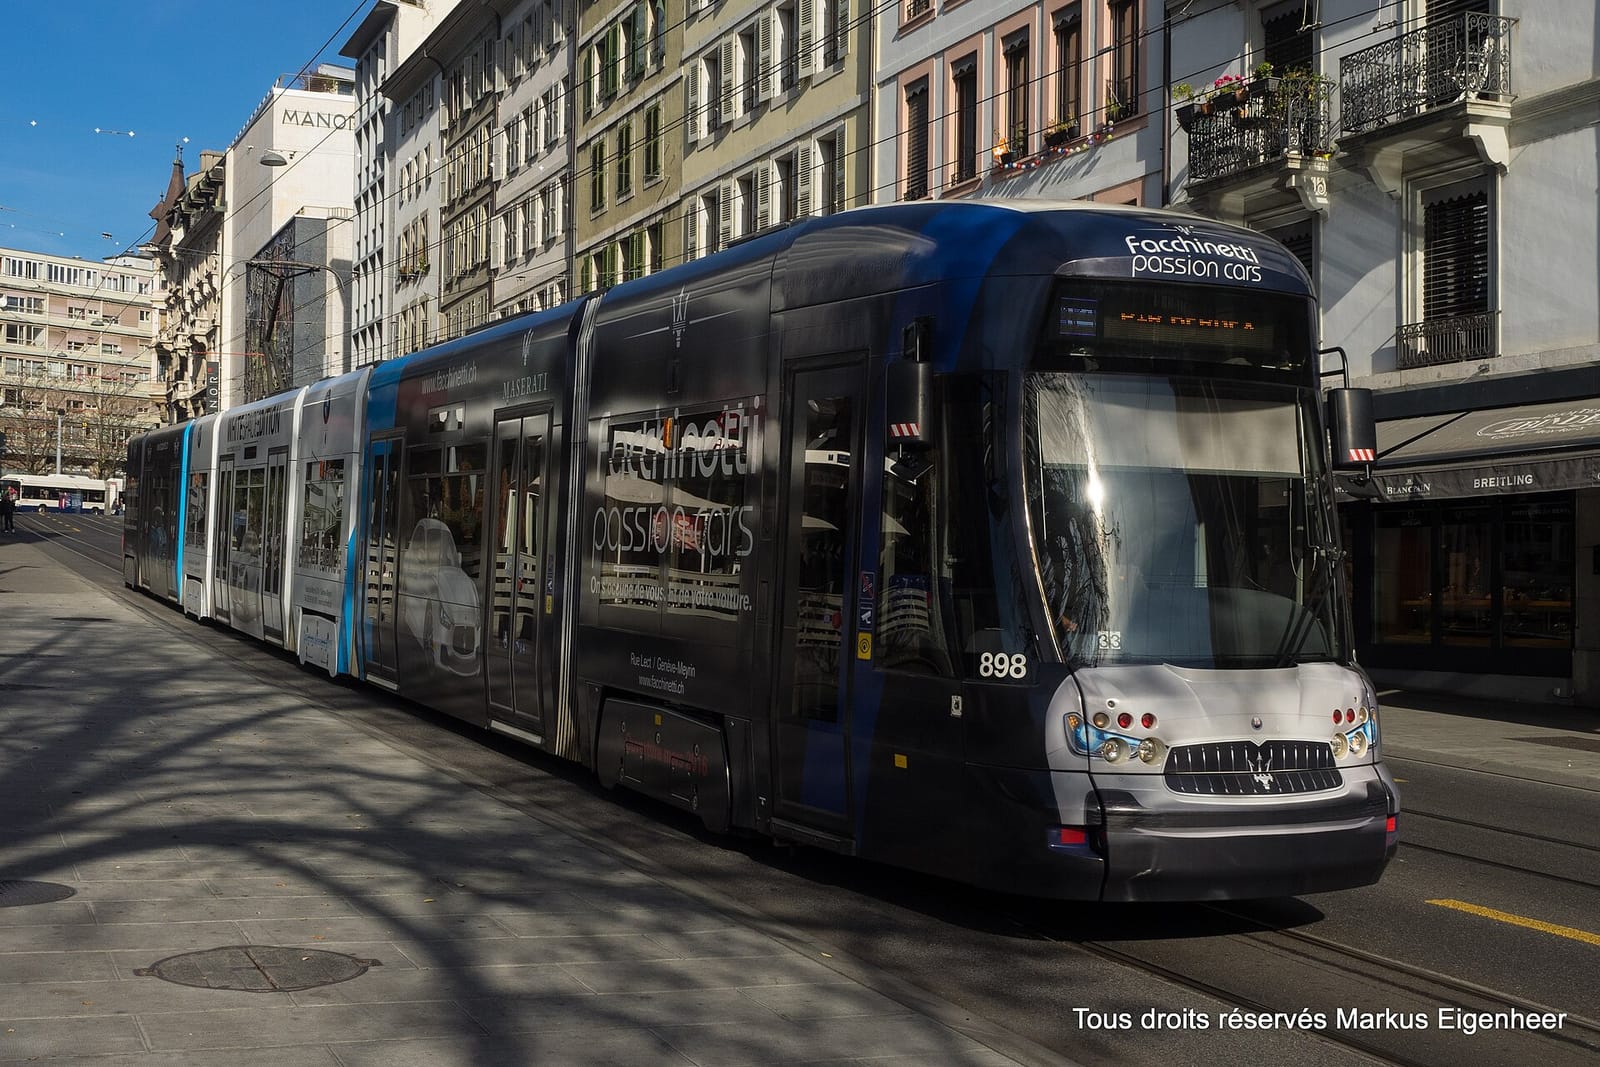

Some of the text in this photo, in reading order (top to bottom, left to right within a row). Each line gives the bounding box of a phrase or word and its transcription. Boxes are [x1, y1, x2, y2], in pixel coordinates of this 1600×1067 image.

[1125, 236, 1259, 264] Facchinetti
[1132, 254, 1262, 282] passion cars
[209, 376, 218, 408] NOR
[502, 372, 548, 400] MASERATI
[1473, 474, 1533, 488] BREITLING
[592, 505, 685, 568] passion
[694, 505, 753, 556] cars
[590, 575, 600, 594] On
[979, 652, 1027, 679] 898
